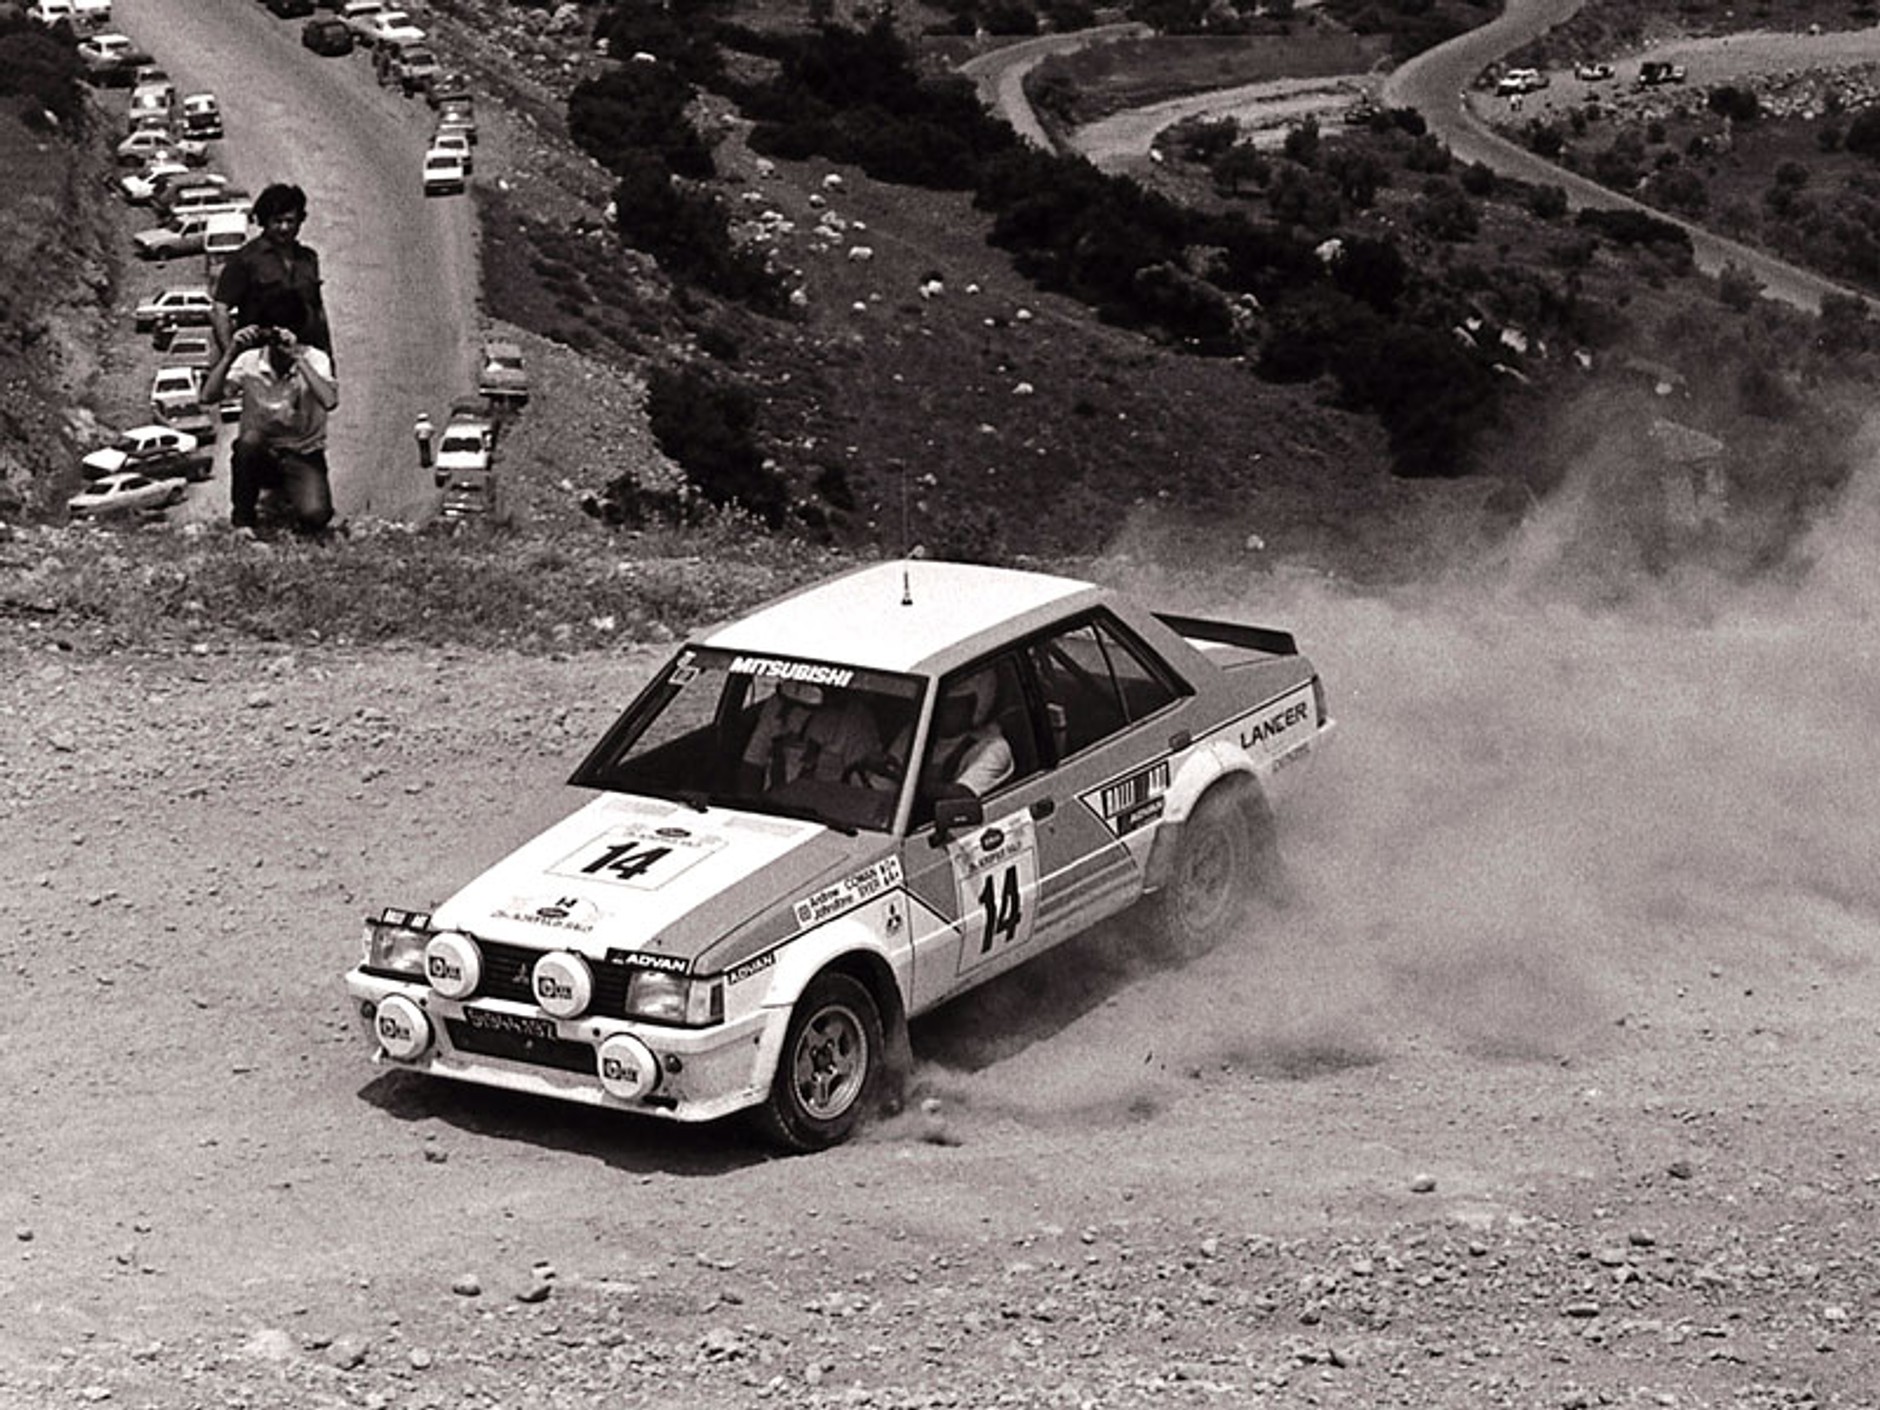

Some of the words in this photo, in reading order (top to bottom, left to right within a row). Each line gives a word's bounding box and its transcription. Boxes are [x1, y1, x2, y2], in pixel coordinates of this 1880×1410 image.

[729, 656, 853, 687] MITSUBISHI
[1240, 702, 1308, 750] LANCER
[580, 841, 673, 880] 14
[978, 865, 1021, 954] 14
[626, 954, 687, 972] ADVAN
[730, 955, 773, 983] ADVAN
